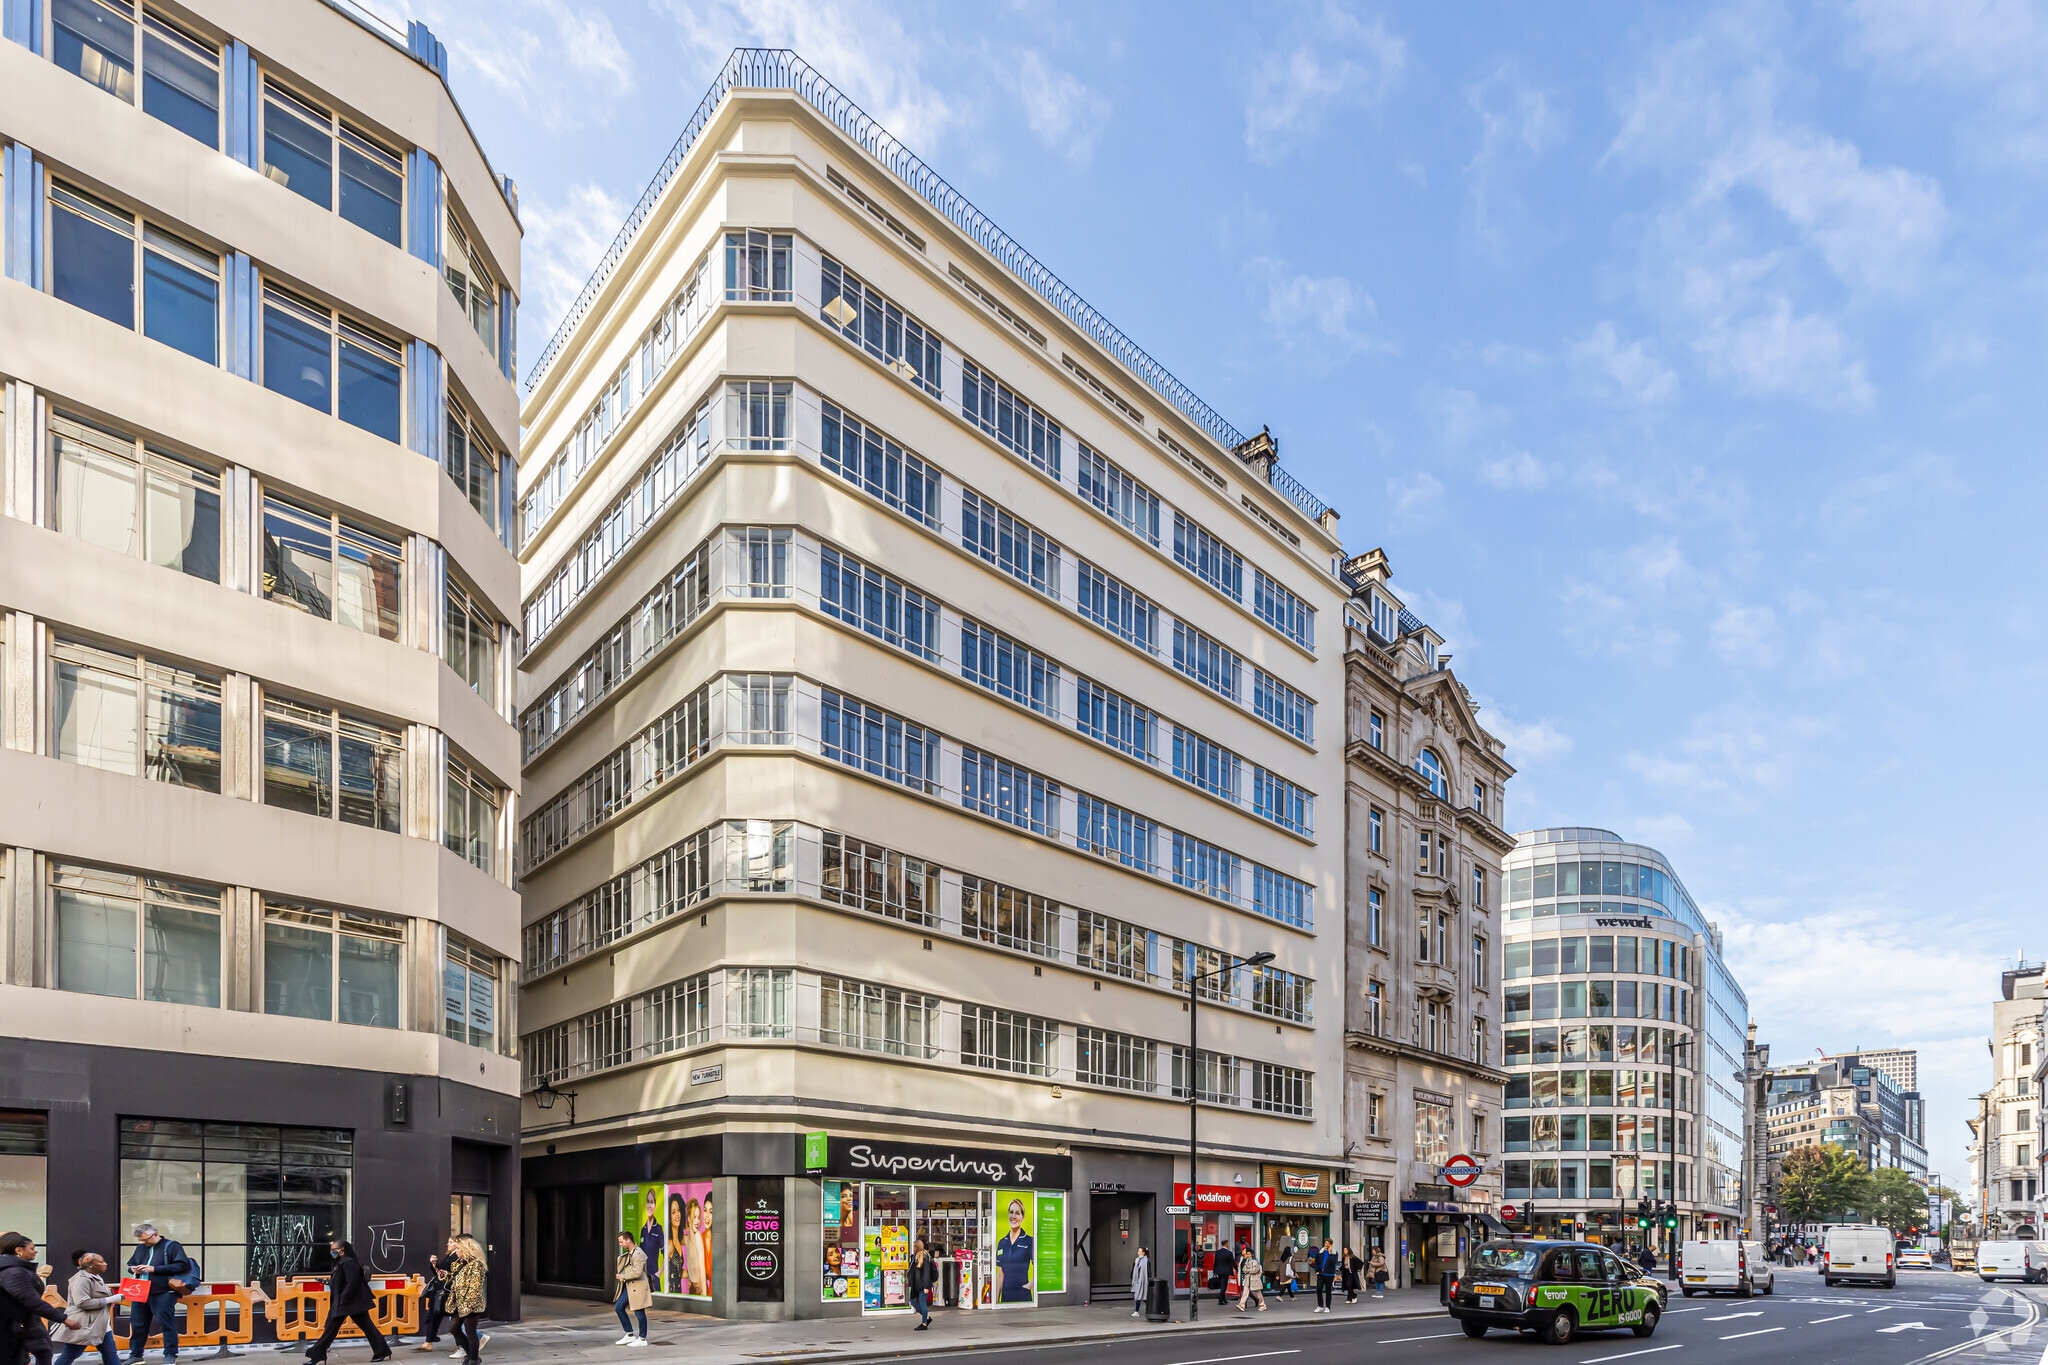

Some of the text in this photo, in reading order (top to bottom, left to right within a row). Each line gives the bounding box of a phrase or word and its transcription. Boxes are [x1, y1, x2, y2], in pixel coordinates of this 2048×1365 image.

[1595, 915, 1653, 929] wework
[849, 1144, 1006, 1182] Superdrug
[1440, 1167, 1481, 1175] UNDERGROUND
[1197, 1192, 1231, 1203] vodafone
[1369, 1186, 1381, 1199] Dry
[745, 1220, 779, 1230] save
[745, 1231, 779, 1241] more
[1587, 1287, 1635, 1321] ZERO
[1618, 1308, 1642, 1325] IS GOOD
